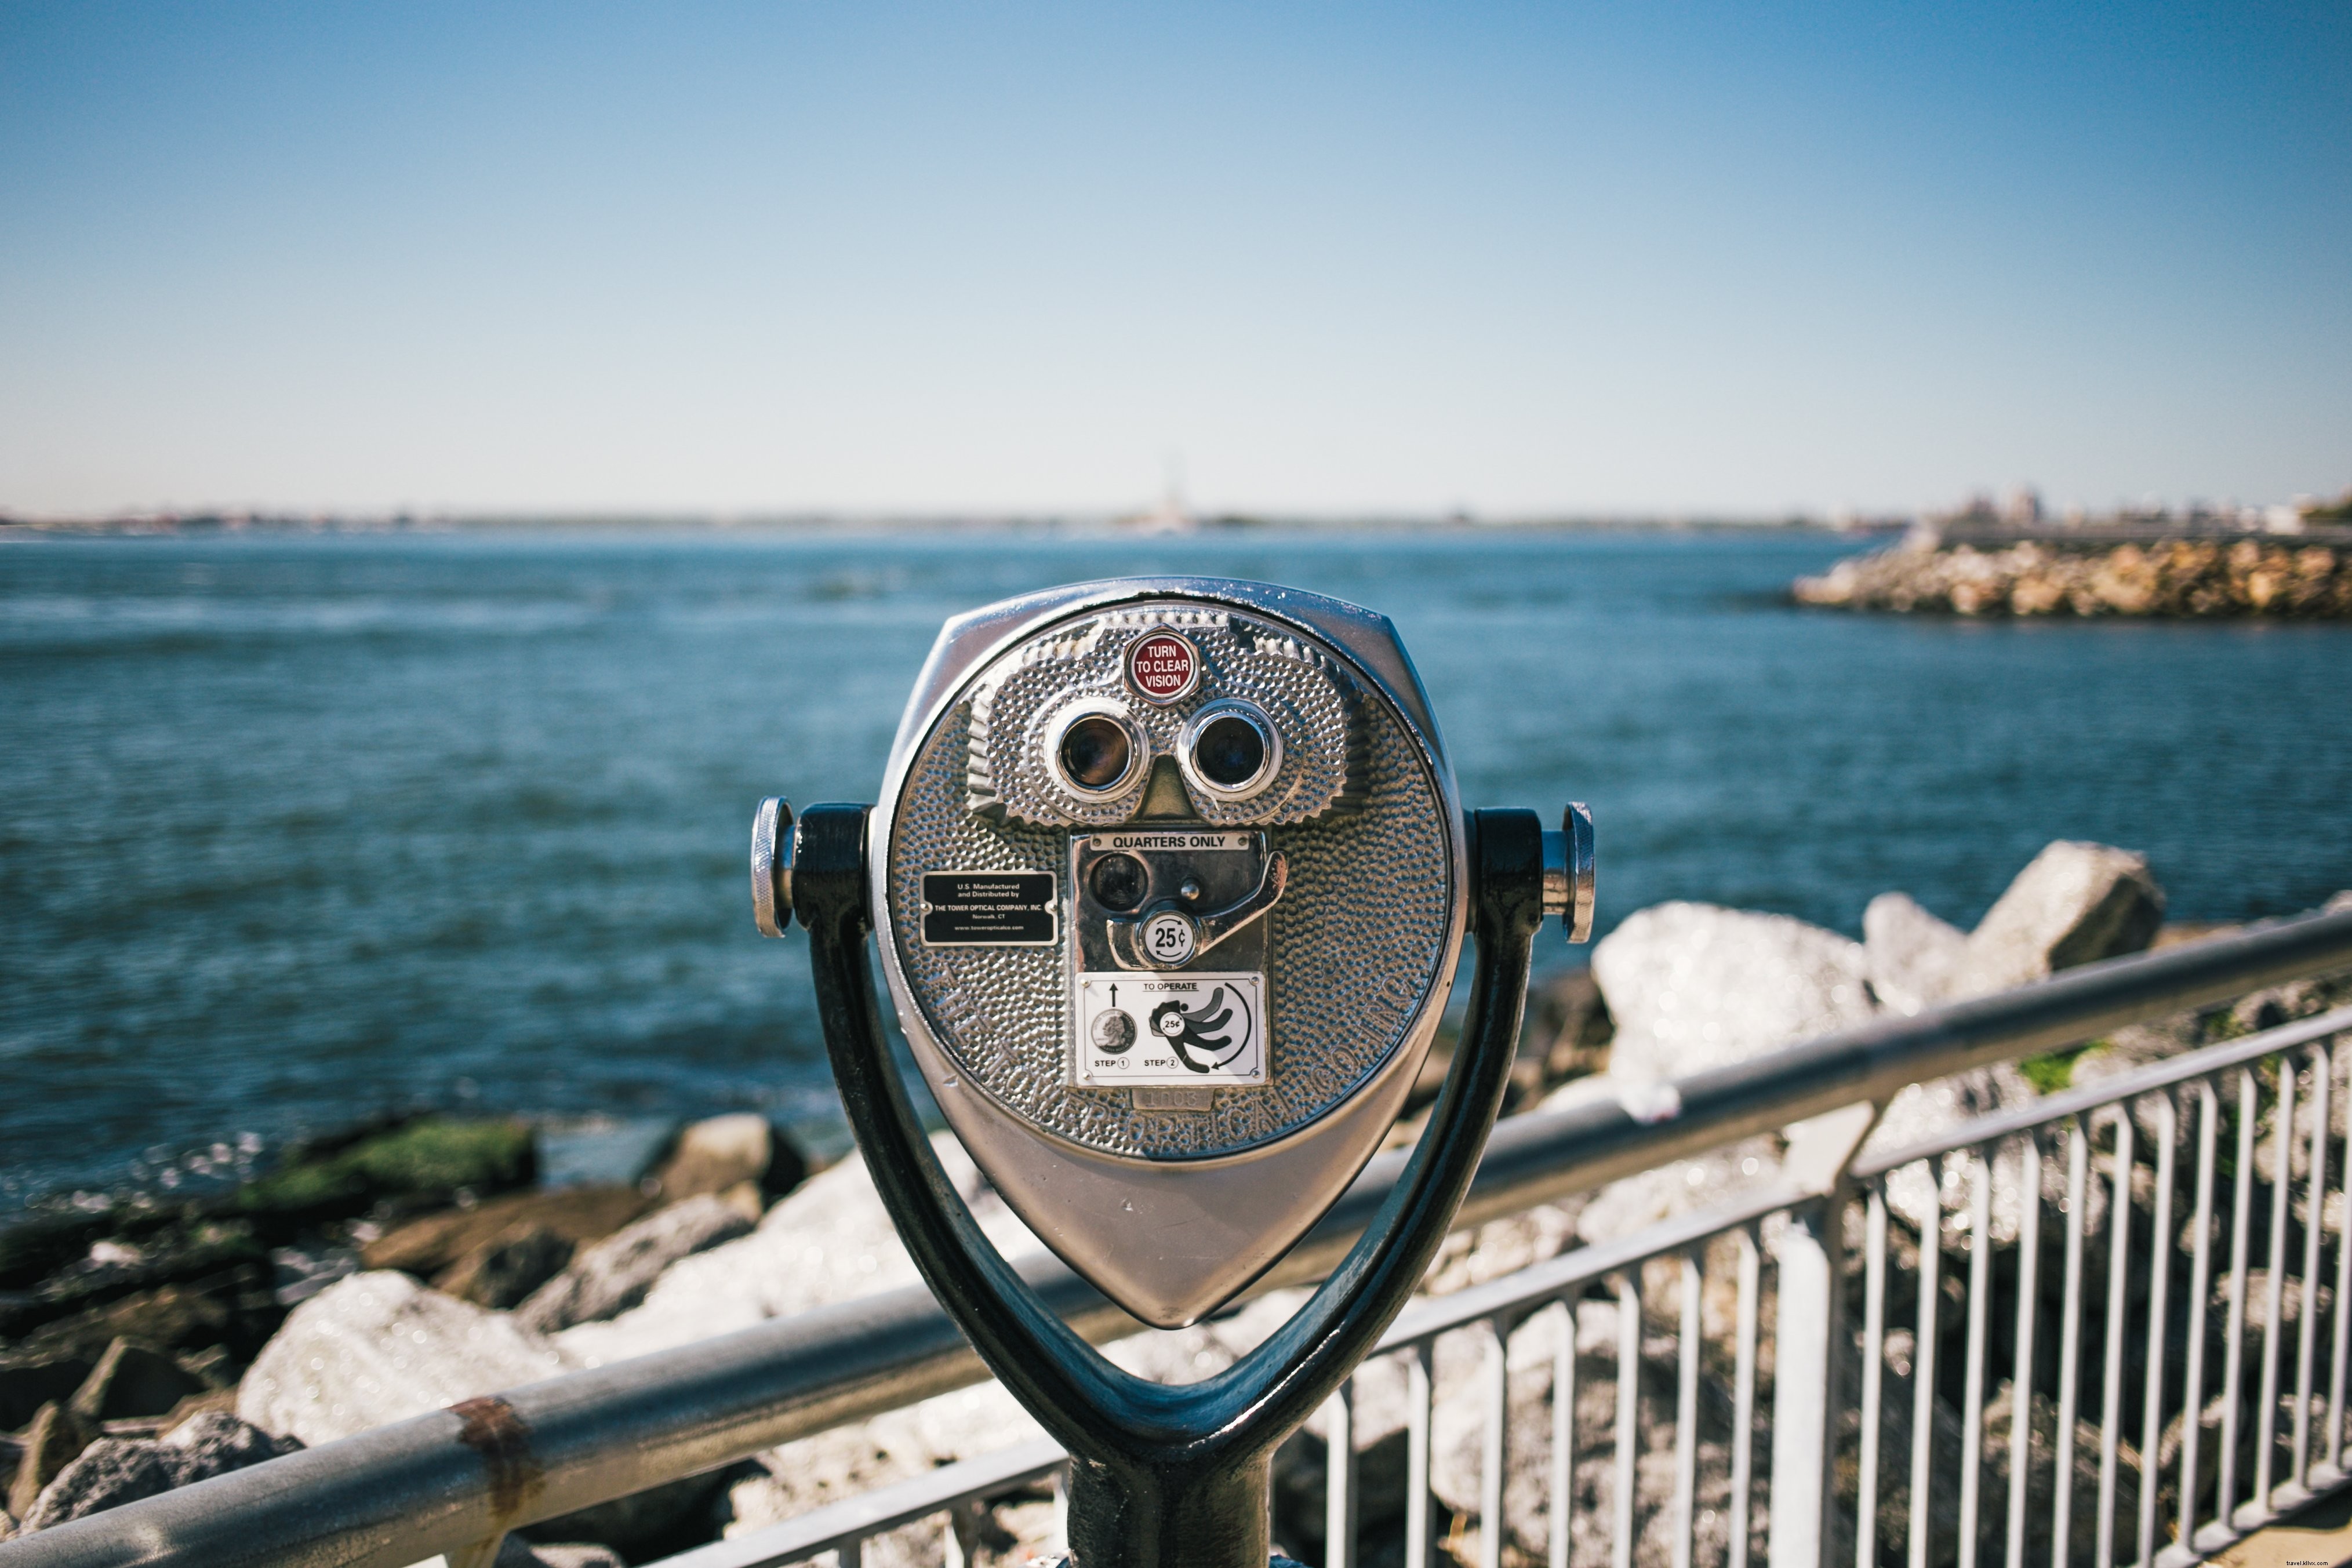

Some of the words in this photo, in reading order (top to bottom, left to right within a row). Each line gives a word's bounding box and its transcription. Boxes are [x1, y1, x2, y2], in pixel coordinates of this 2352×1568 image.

[1147, 645, 1176, 658] TURN
[1136, 661, 1151, 673] TO
[1154, 660, 1188, 672] CLEAR
[1146, 674, 1181, 687] VISION
[1113, 836, 1186, 848] QUARTERS
[1190, 836, 1226, 847] ONLY
[1155, 928, 1186, 948] 25¢
[1165, 1020, 1180, 1028] 25¢
